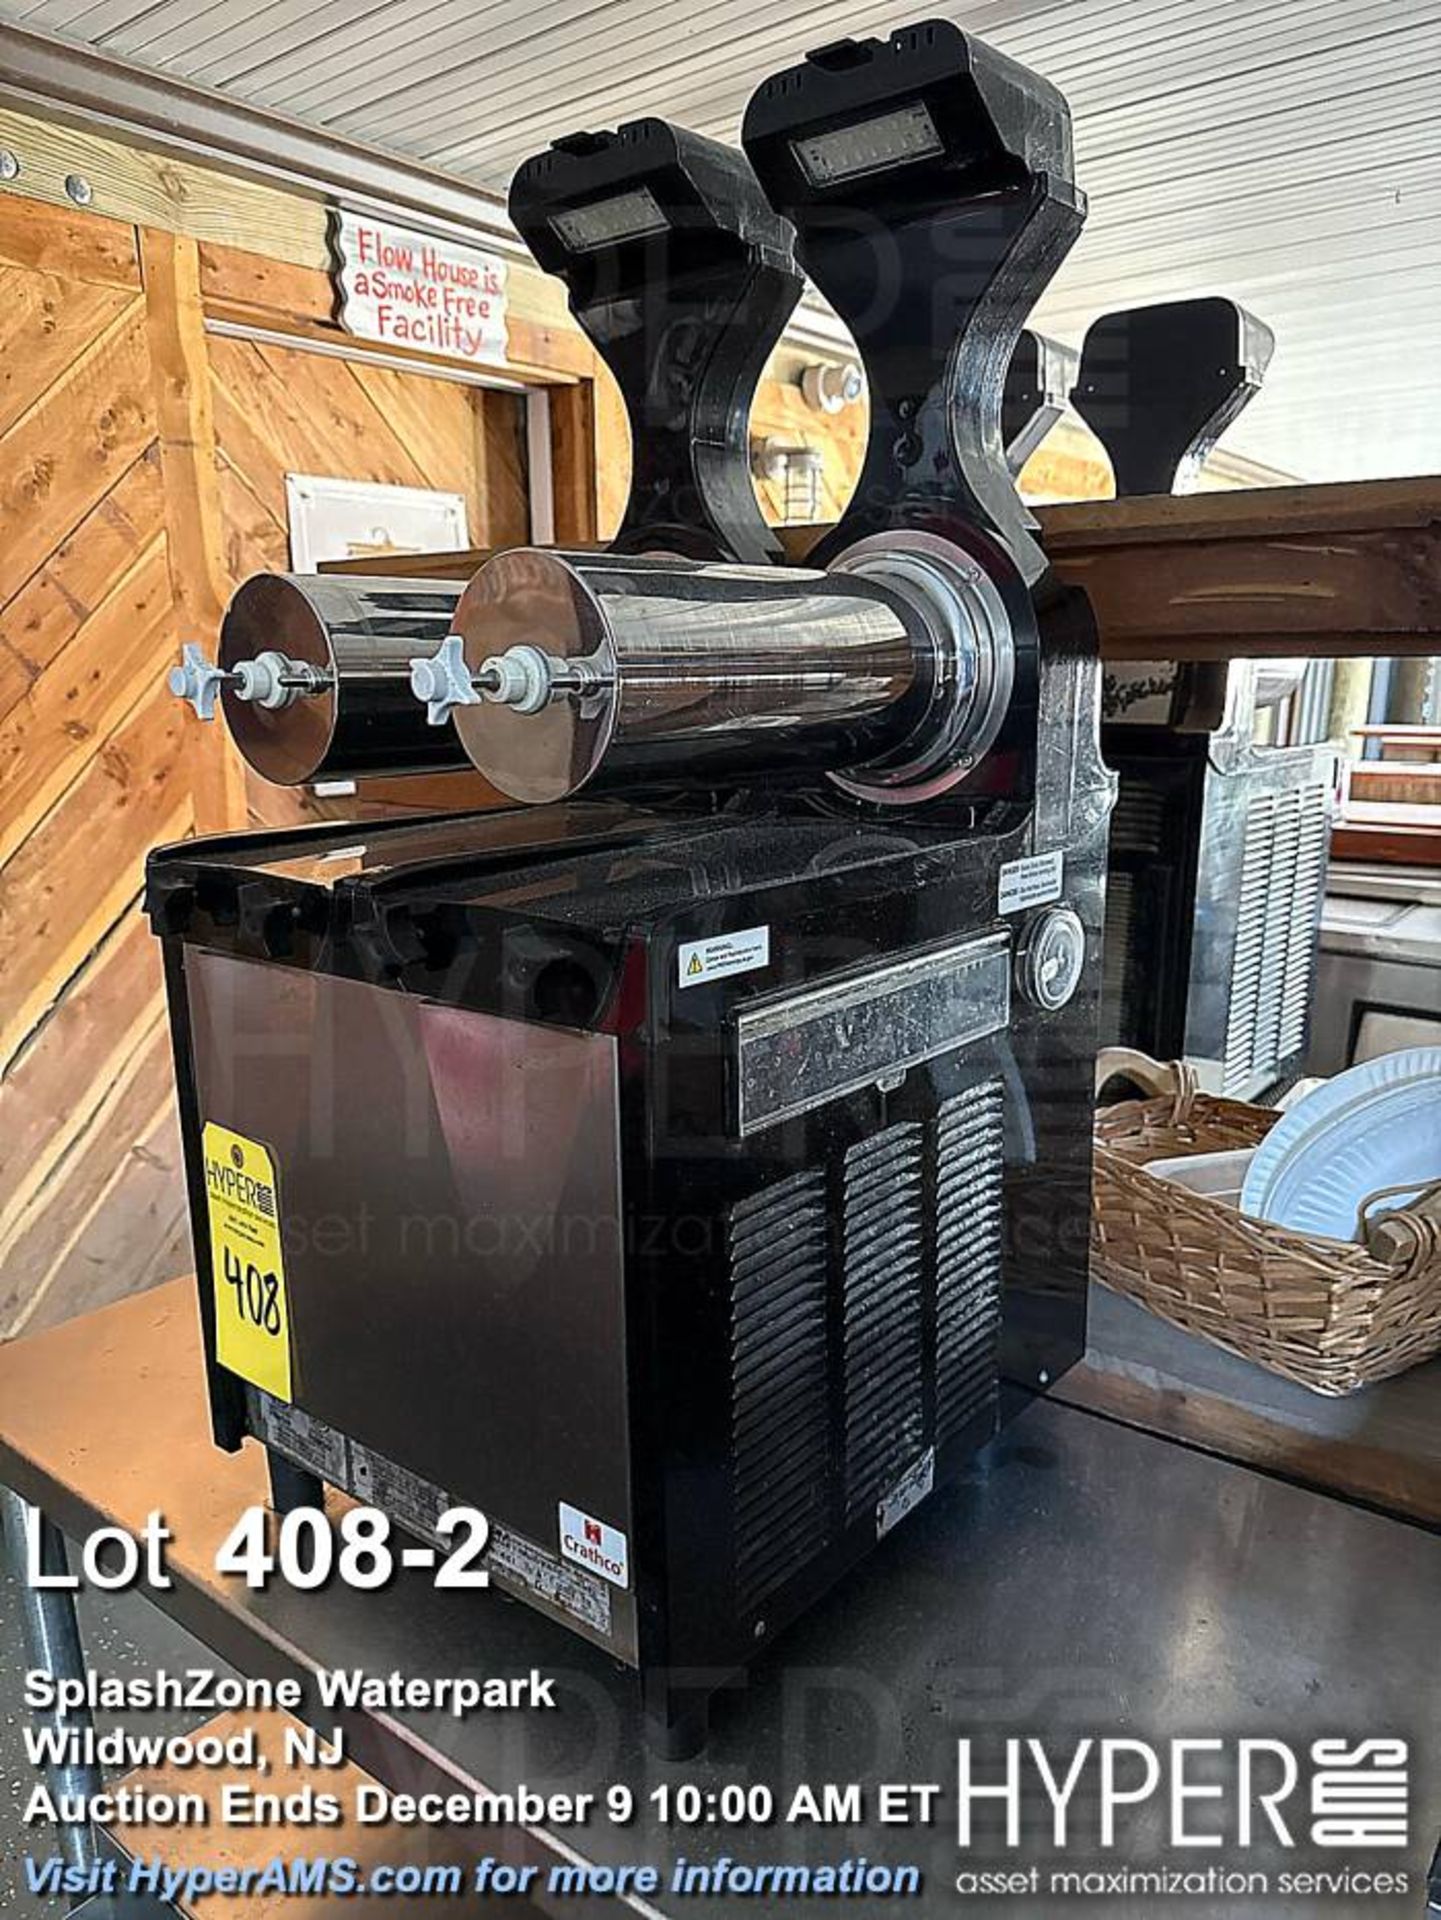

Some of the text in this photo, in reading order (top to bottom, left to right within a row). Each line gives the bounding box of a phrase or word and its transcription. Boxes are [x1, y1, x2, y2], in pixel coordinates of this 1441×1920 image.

[358, 227, 413, 272] Flow
[421, 246, 478, 288] House
[443, 286, 490, 318] Free
[377, 305, 483, 356] Facility
[205, 1157, 257, 1207] HYPER
[224, 1245, 281, 1336] 408
[563, 1534, 622, 1577] Crathco
